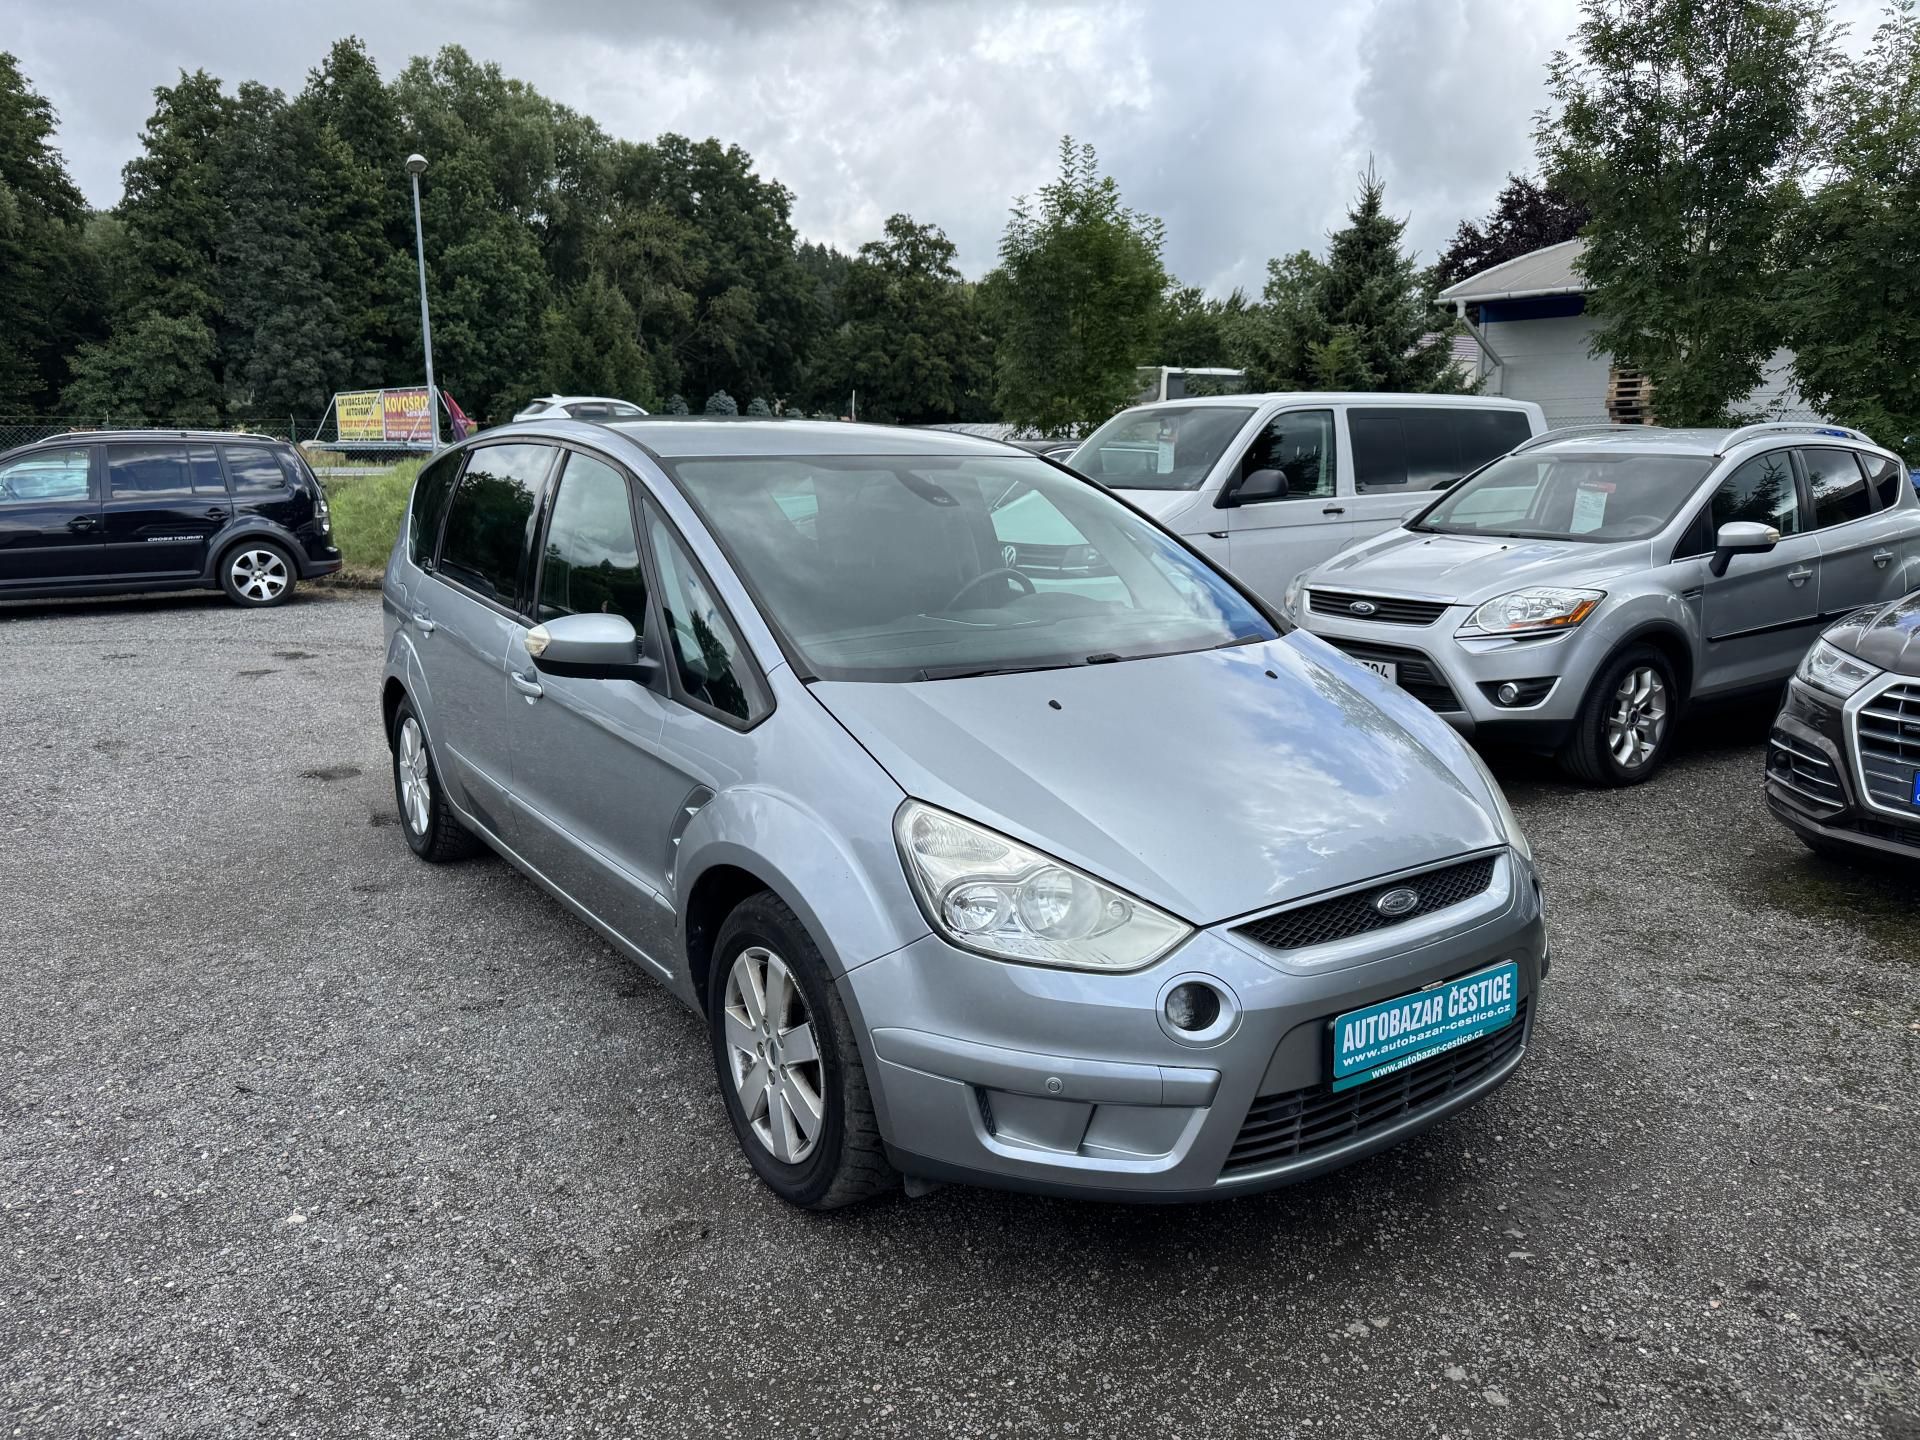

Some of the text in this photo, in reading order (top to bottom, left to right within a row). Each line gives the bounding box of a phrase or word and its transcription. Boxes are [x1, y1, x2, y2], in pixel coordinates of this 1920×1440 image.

[384, 394, 429, 412] KOVOŠRO
[1342, 972, 1511, 1054] AUTOBAZAR ČESTICE
[1343, 1004, 1511, 1066] www.autobazar-cestice.cz
[1371, 1028, 1484, 1079] www.autobazar-cestice.cz
